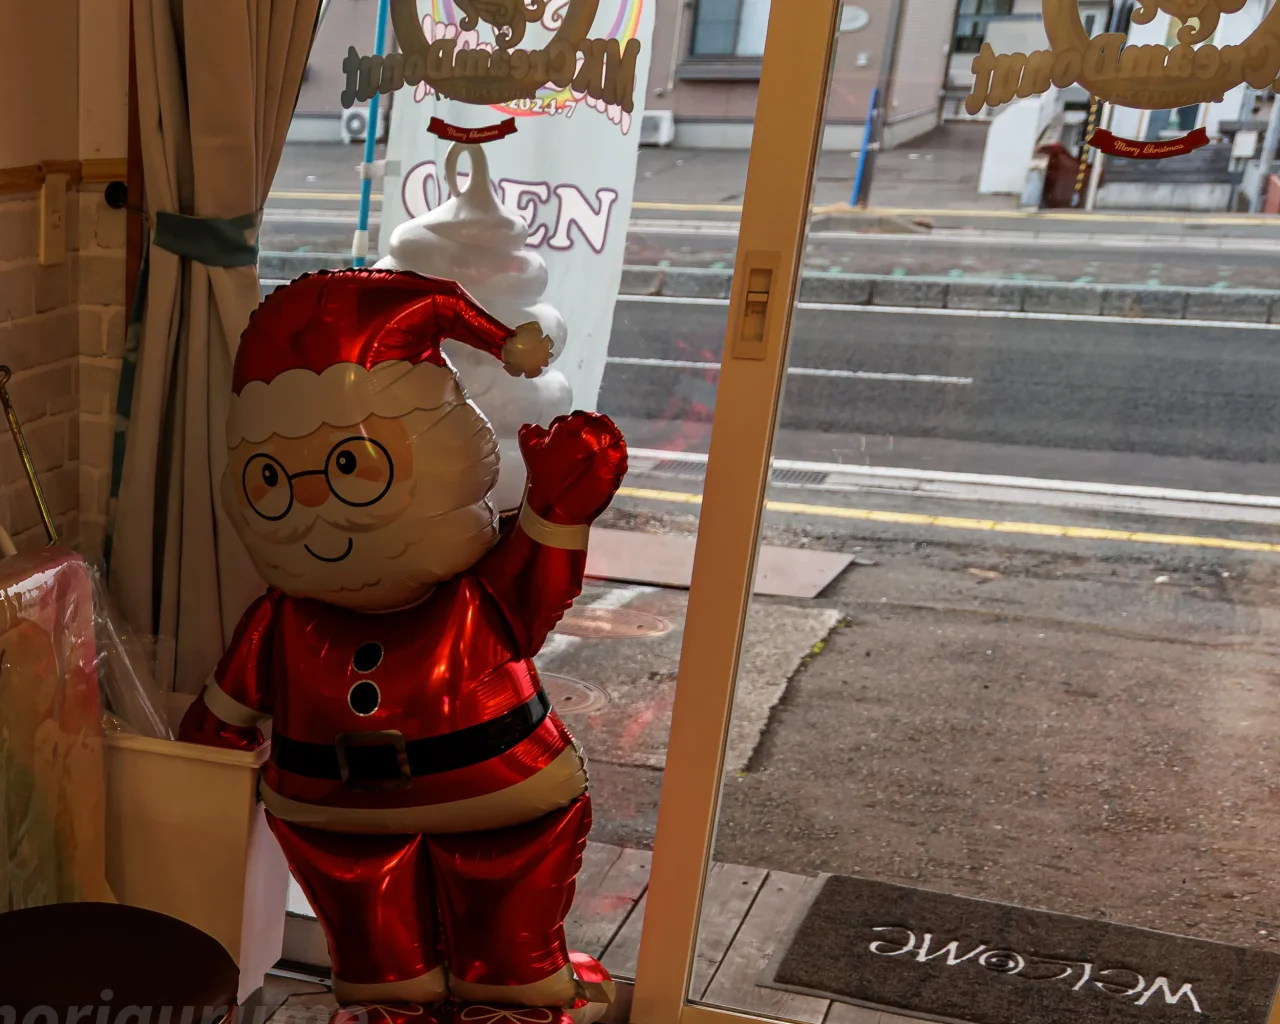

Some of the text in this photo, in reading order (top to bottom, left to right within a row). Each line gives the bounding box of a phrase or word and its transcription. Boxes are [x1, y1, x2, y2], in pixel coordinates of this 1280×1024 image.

[446, 126, 499, 140] Merry Christmas
[1114, 140, 1184, 156] Merry Christmas
[401, 160, 618, 254] OEN
